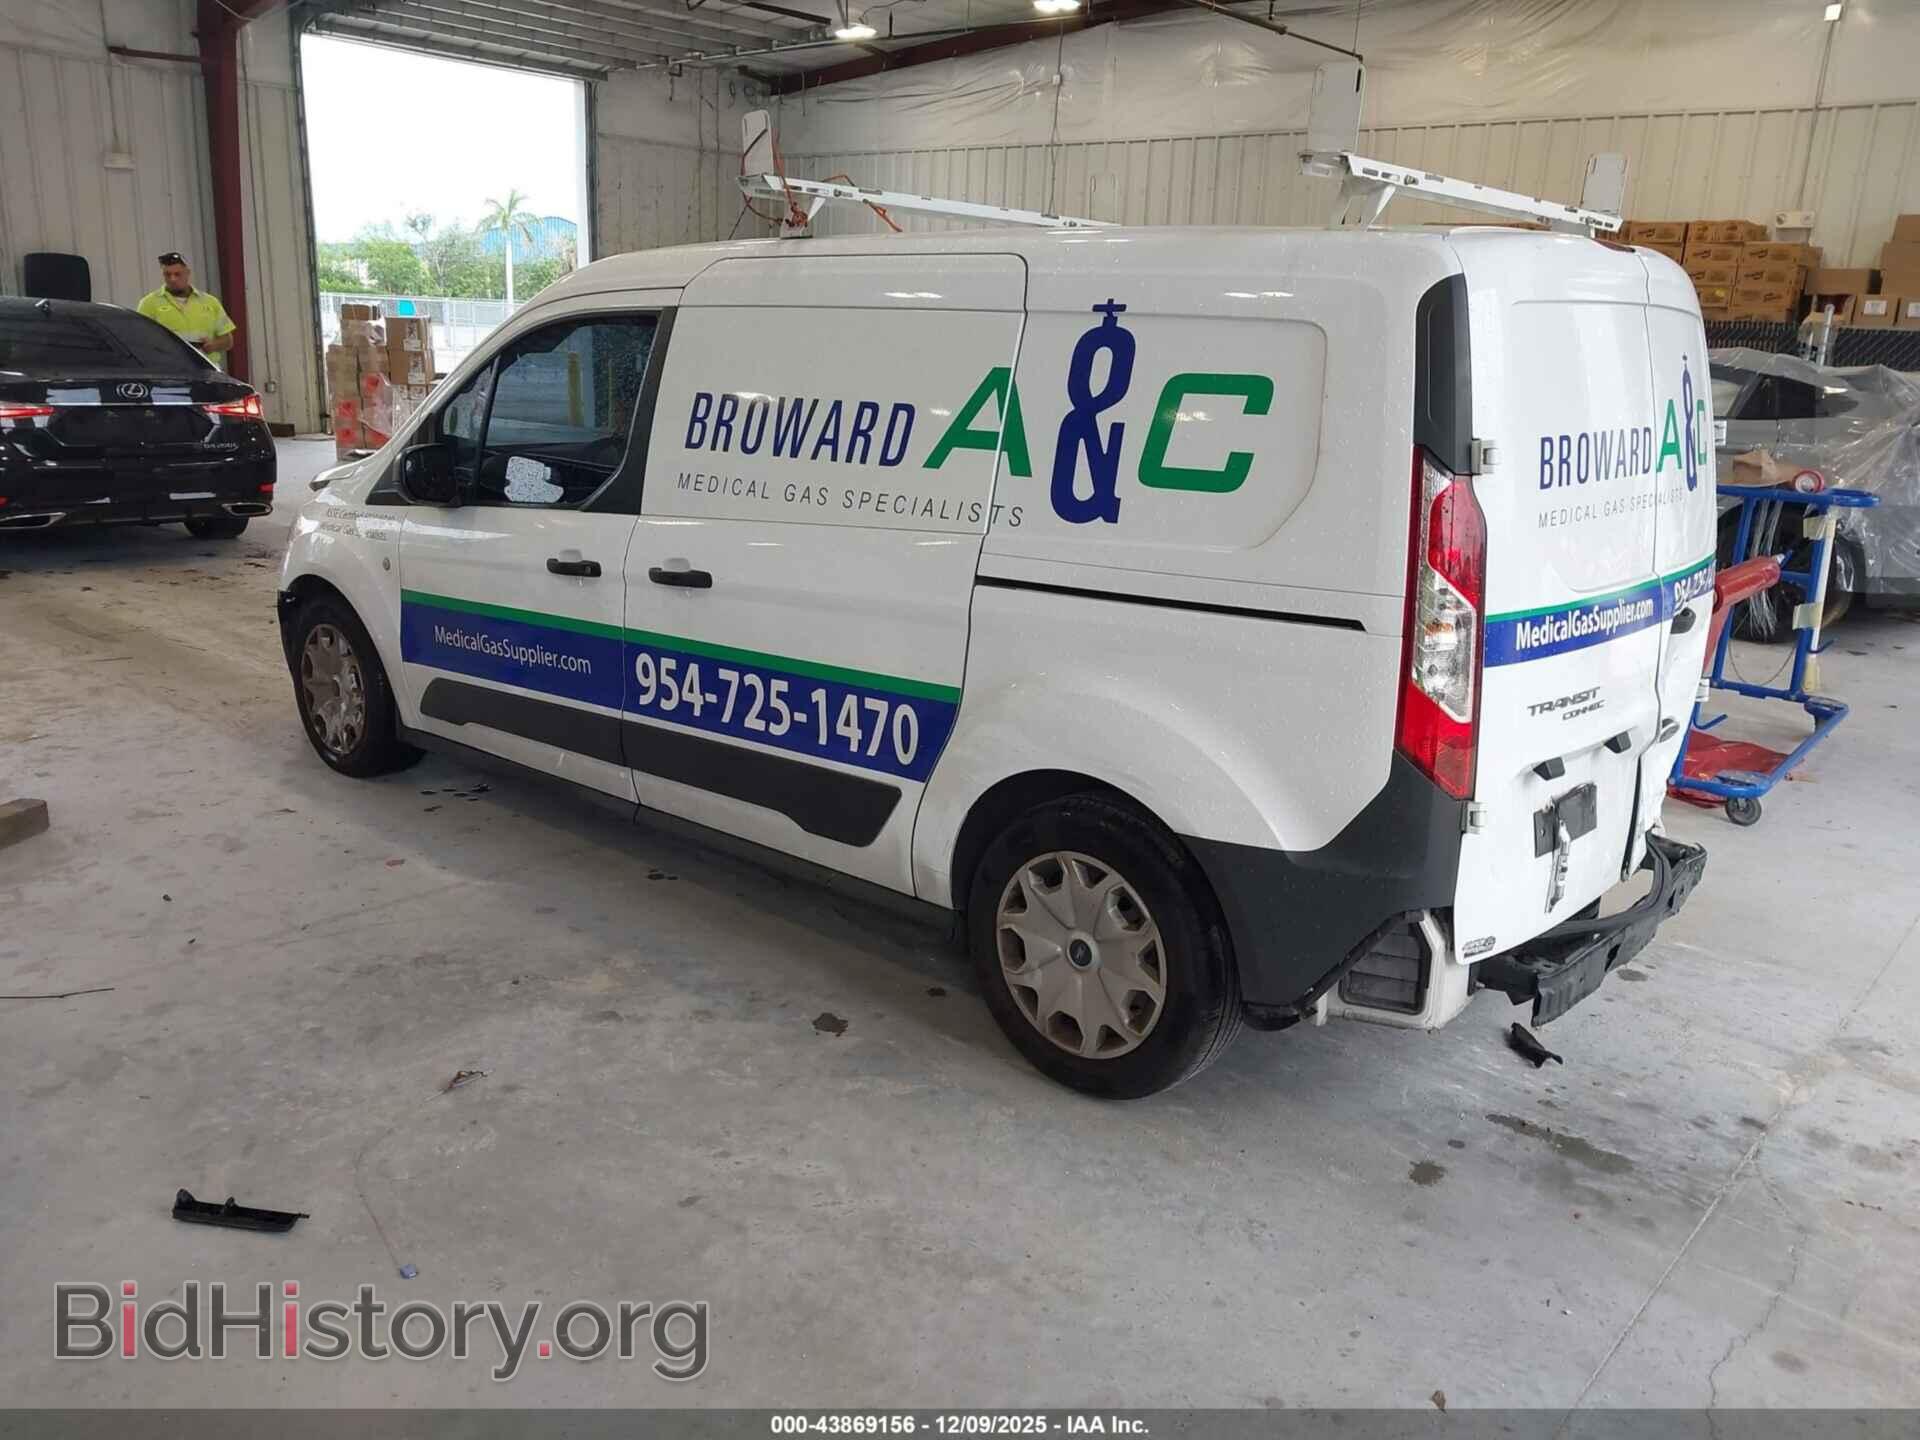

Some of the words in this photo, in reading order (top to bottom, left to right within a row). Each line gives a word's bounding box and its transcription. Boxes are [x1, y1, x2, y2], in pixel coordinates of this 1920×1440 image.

[685, 392, 915, 467] BROWARD
[1540, 427, 1651, 490] BROWARD
[678, 472, 770, 499] MEDICAL
[784, 483, 829, 506] GAS
[842, 490, 1024, 527] SPECIALISTS
[1538, 504, 1597, 529] MEDICAL
[1604, 499, 1625, 517] GAS
[434, 625, 592, 675] MedicalGasSupplier.com
[1515, 598, 1654, 651] MedicalGasSupplier.com
[635, 652, 919, 766] 954-725-1470
[1527, 686, 1604, 717] TRANSIT
